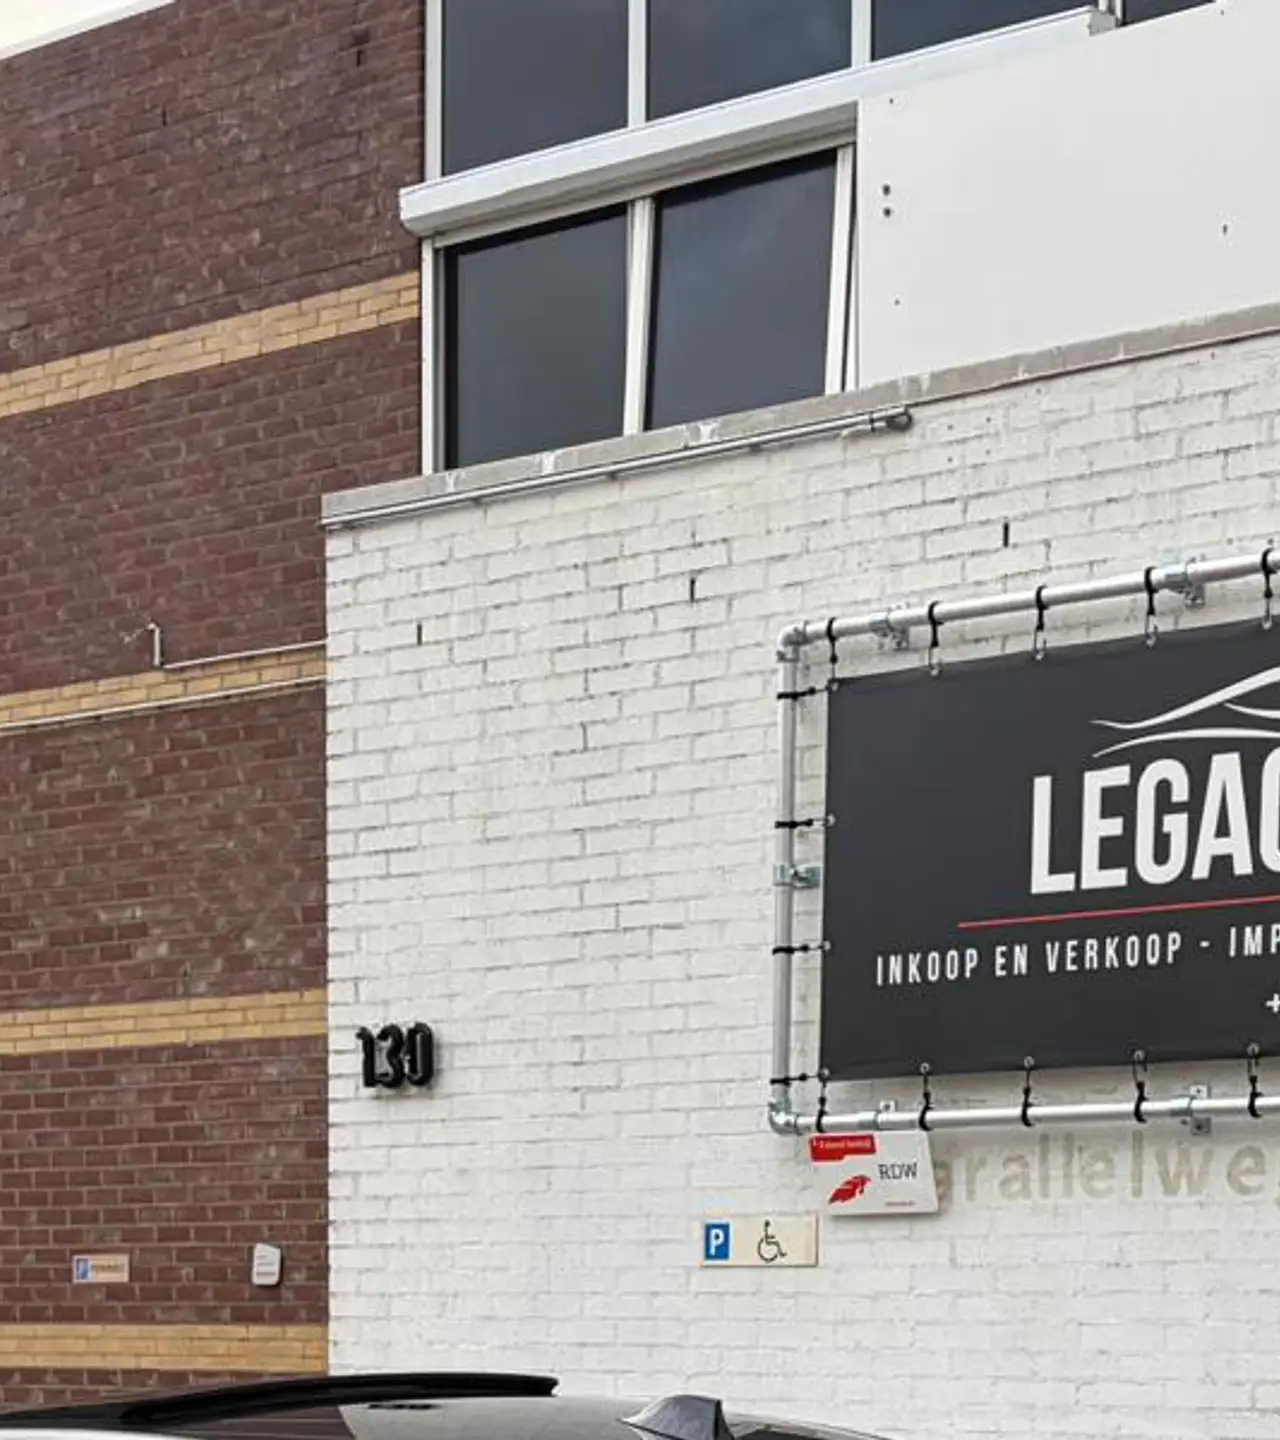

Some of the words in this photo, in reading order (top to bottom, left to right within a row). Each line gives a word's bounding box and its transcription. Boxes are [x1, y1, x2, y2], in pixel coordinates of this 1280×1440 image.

[875, 948, 980, 986] INKOOP
[995, 943, 1028, 977] EN
[1046, 931, 1182, 973] VERKOOP
[356, 1022, 435, 1089] 130
[877, 1161, 918, 1181] RDW
[709, 1228, 725, 1257] P
